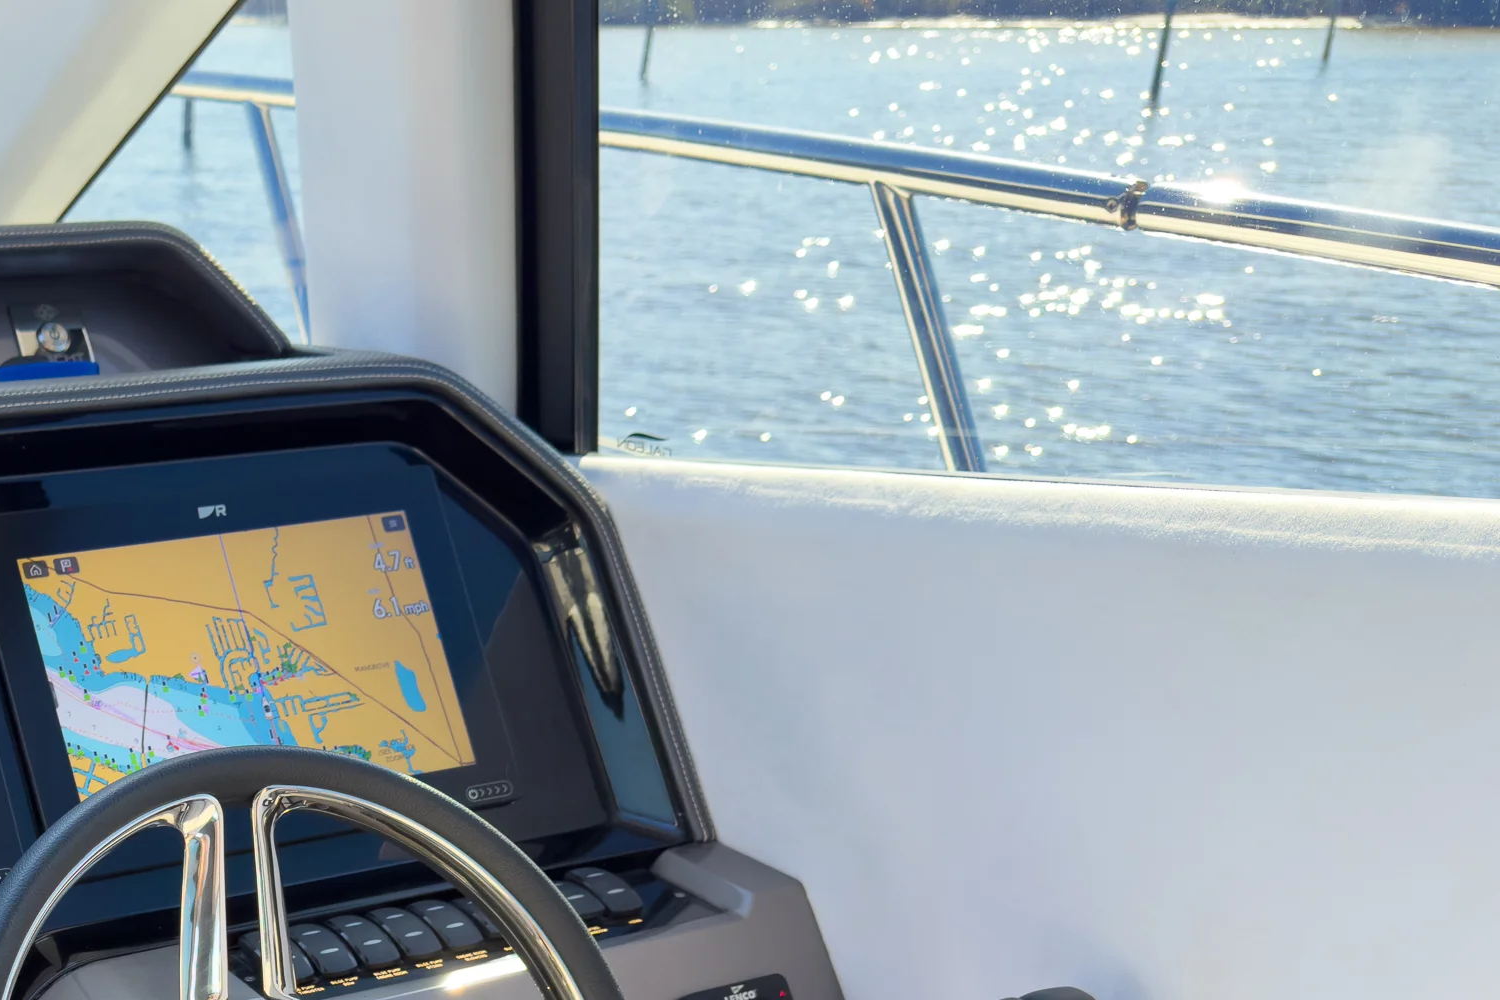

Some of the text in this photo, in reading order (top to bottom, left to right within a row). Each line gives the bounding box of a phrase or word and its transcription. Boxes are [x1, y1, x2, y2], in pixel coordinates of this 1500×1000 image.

[373, 551, 415, 572] 4.7 ft
[373, 597, 430, 619] 6.1 mph
